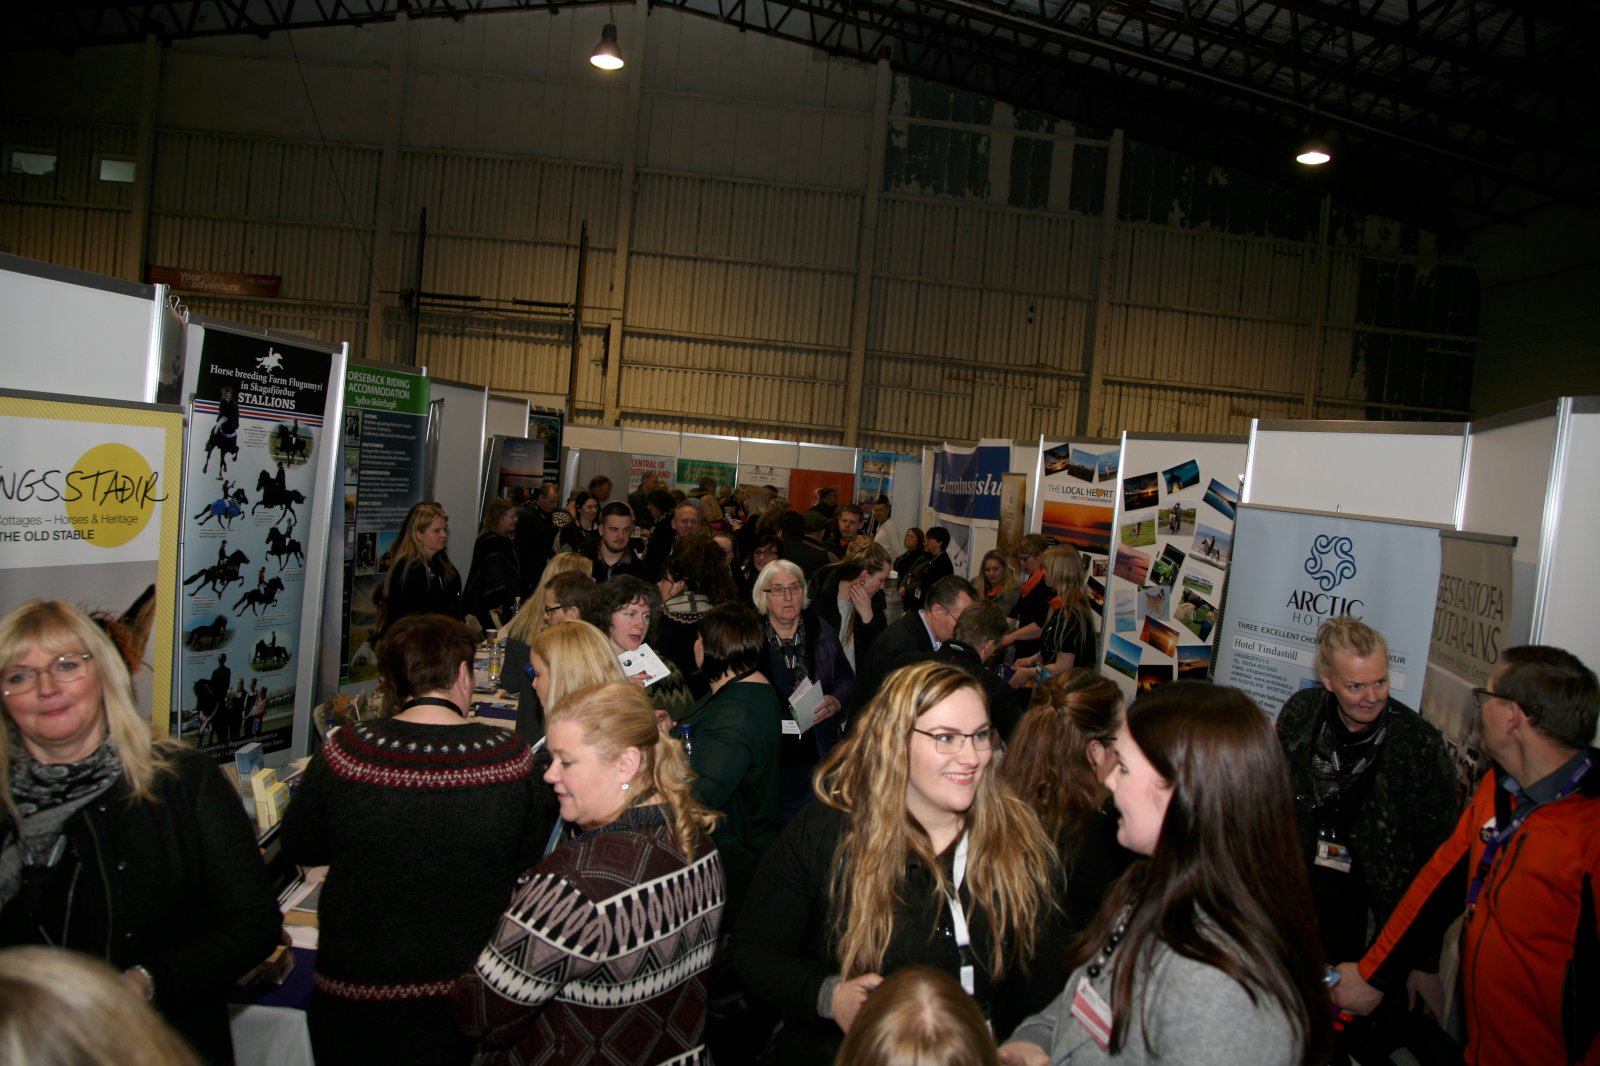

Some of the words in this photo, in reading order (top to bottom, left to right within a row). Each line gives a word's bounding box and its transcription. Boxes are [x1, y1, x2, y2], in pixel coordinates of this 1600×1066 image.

[179, 270, 202, 282] Your
[191, 280, 240, 292] adventure
[210, 364, 234, 377] Horse
[235, 368, 267, 384] breeding
[268, 374, 288, 386] Farm
[347, 370, 386, 385] ORSEBACK
[386, 376, 410, 389] RIDING
[240, 380, 249, 390] in
[250, 382, 296, 398] Skagafjörður
[348, 383, 410, 399] ACCOMMODATION
[237, 392, 296, 410] STALLIONS
[631, 459, 656, 468] CENTRAL
[658, 460, 667, 469] OF
[1048, 484, 1061, 494] THE
[1062, 486, 1084, 496] LOCAL
[54, 514, 88, 525] Horses
[92, 515, 98, 525] &
[102, 514, 138, 526] Heritage
[24, 531, 49, 542] OLD
[53, 529, 95, 541] STABLE
[1286, 589, 1364, 621] ARCTIC
[1292, 611, 1323, 627] HOT
[1238, 621, 1258, 632] THREE
[1260, 624, 1299, 641] EXCELLENT
[1300, 635, 1317, 645] CHO
[1234, 638, 1255, 651] Hotel
[1258, 644, 1298, 661] Tindastóll
[1388, 653, 1406, 664] KUR
